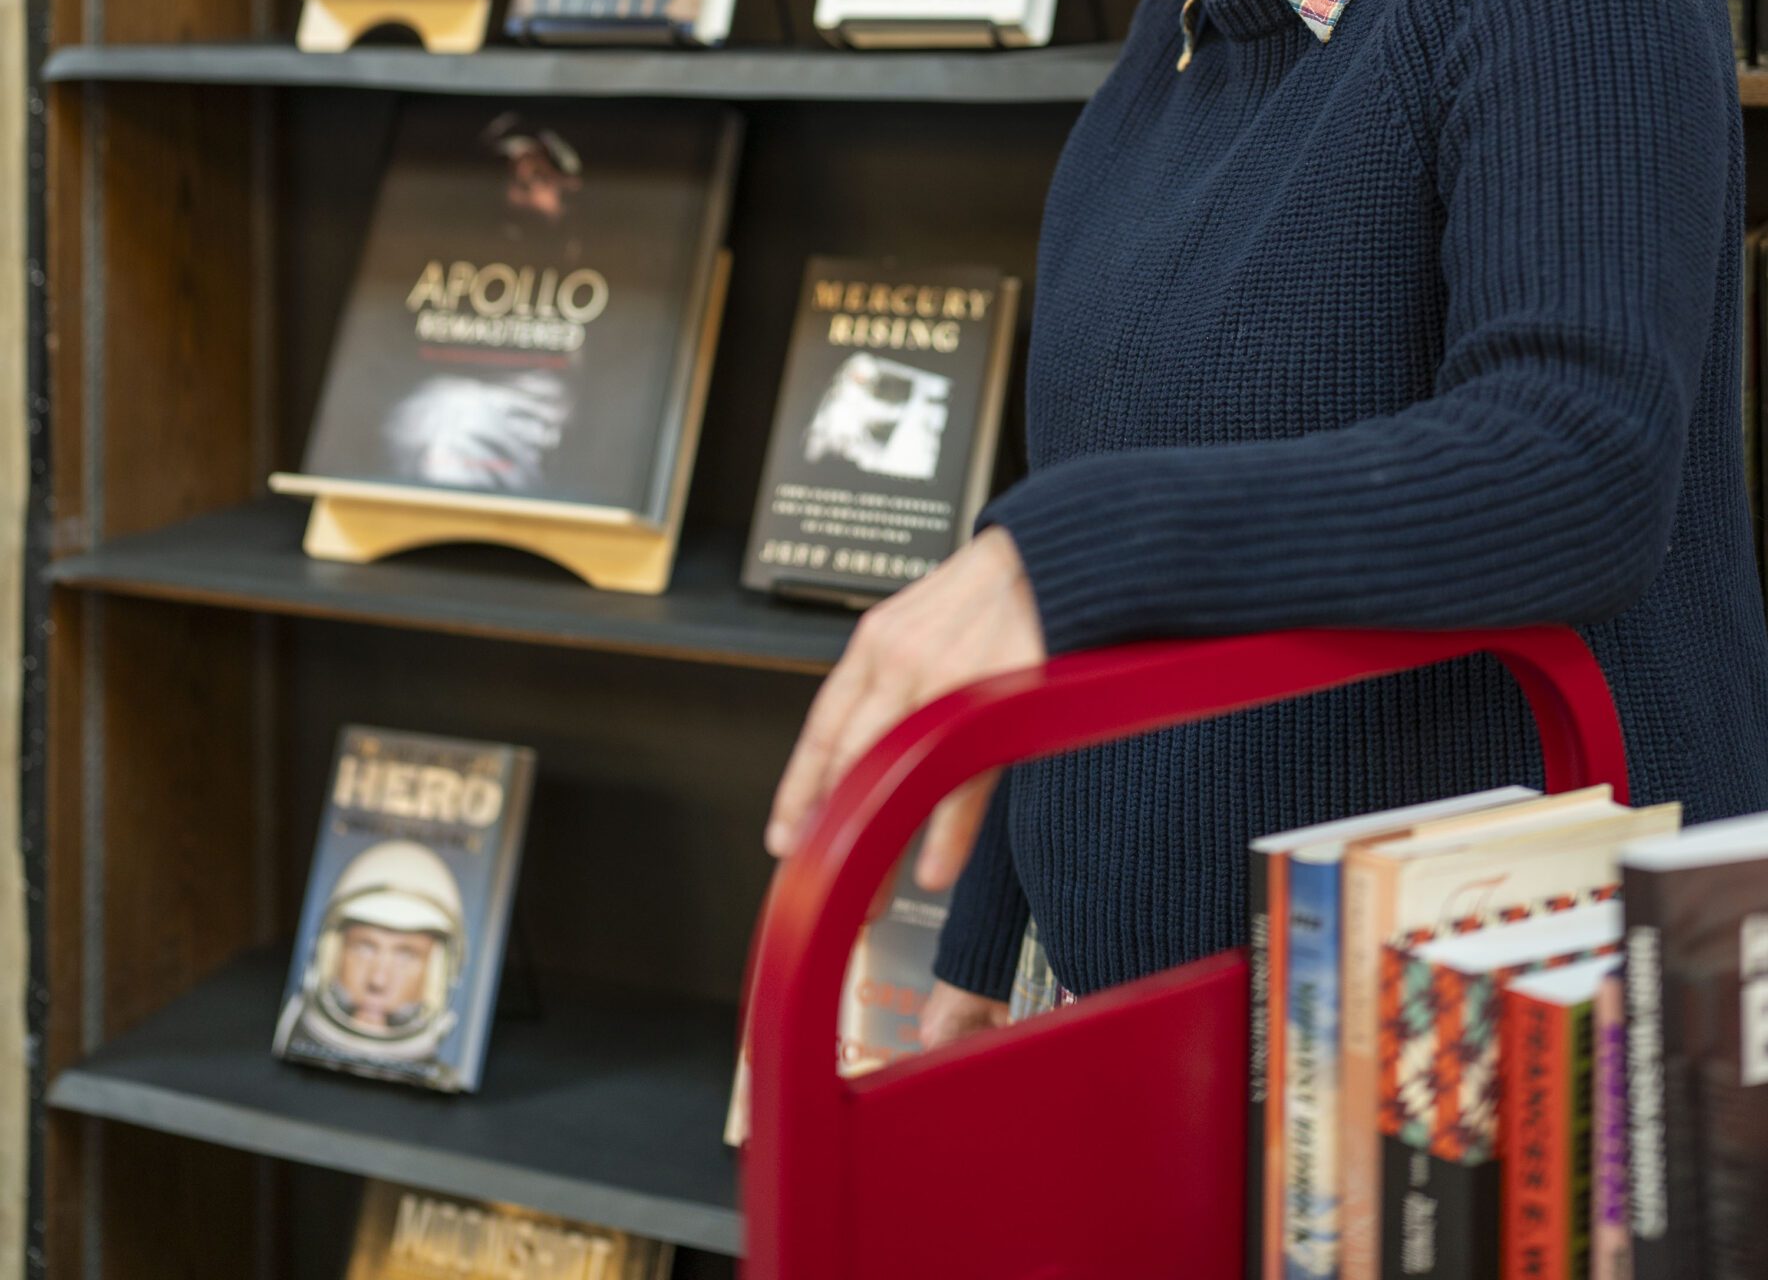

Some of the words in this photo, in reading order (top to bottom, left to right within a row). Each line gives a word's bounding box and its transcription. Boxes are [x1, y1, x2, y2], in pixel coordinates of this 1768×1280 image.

[405, 260, 609, 324] APOLLO
[812, 280, 993, 320] MERCURY
[829, 313, 961, 353] RISING
[335, 755, 504, 829] HERO
